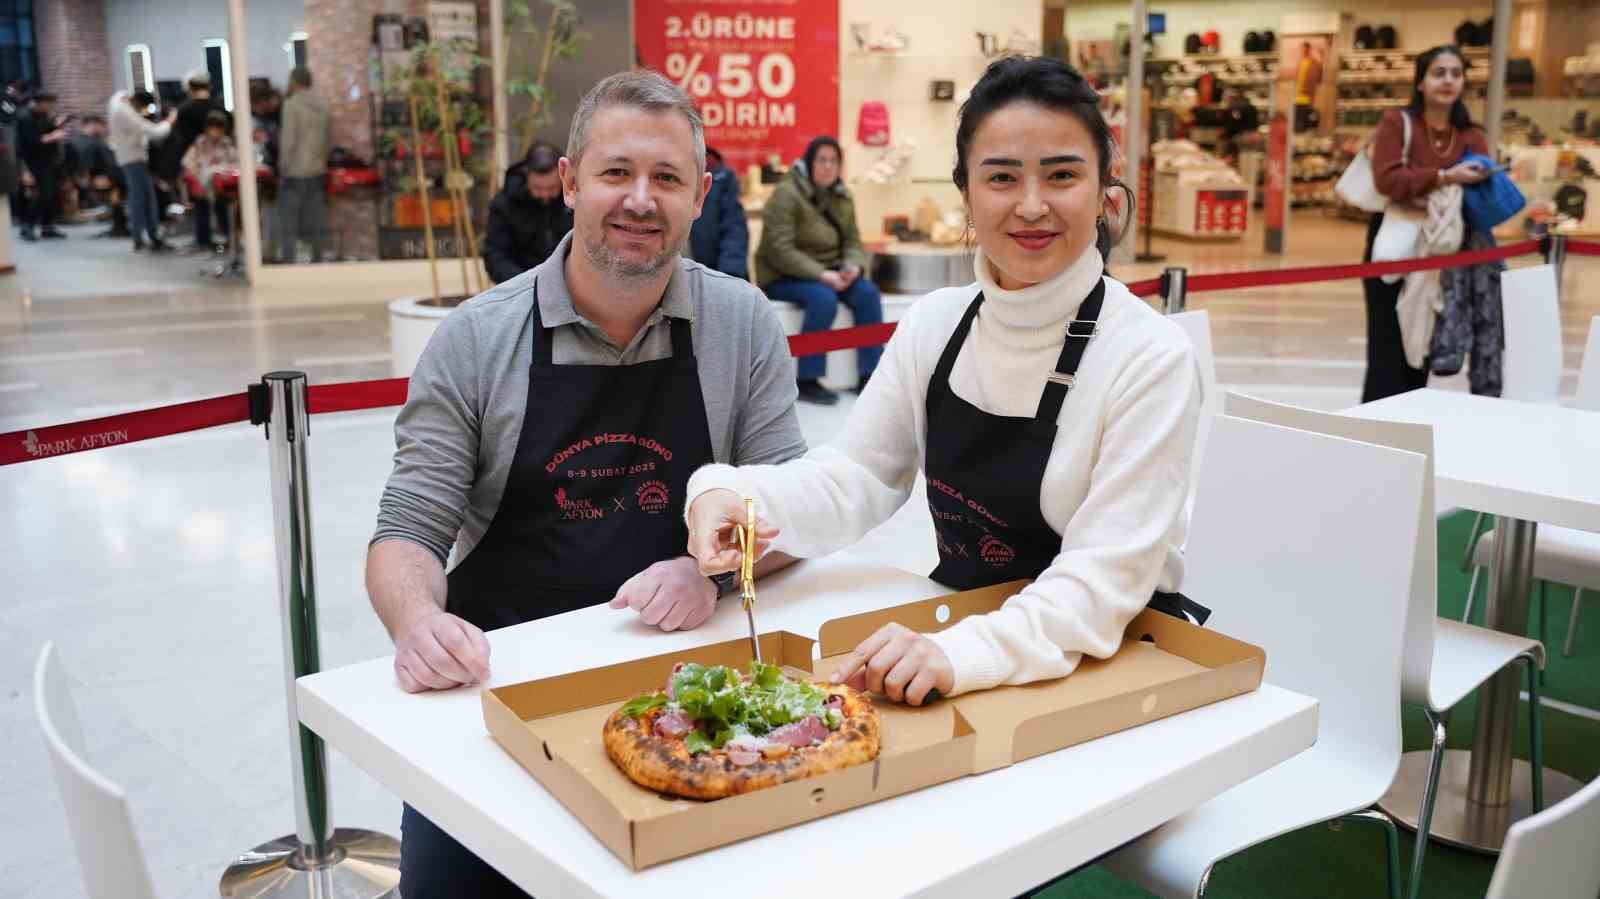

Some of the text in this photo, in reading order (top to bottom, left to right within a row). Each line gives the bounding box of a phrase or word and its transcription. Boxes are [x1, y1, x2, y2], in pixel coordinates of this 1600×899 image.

[665, 52, 796, 98] %50
[702, 100, 796, 127] DİRİM
[37, 429, 129, 457] PARK AFYON
